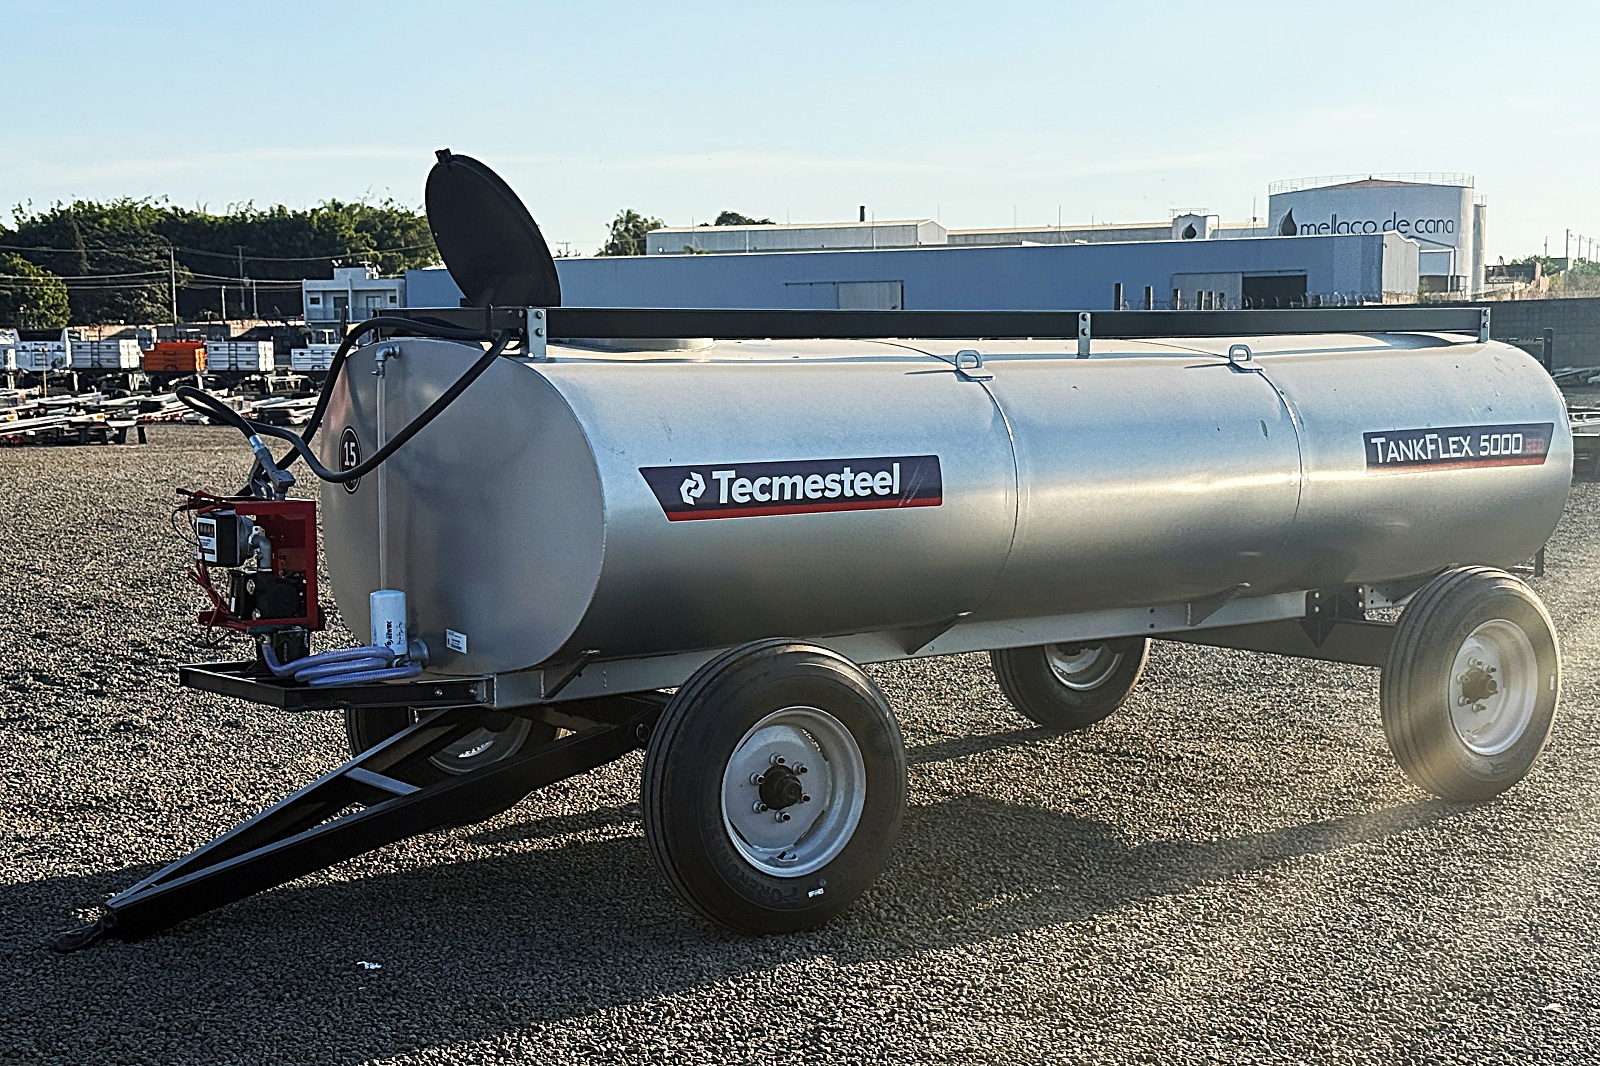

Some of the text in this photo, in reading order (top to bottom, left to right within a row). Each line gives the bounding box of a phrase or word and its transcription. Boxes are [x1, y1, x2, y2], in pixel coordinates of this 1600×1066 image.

[1382, 211, 1411, 234] de
[1414, 218, 1455, 234] cana
[343, 441, 357, 467] 15
[1479, 433, 1523, 456] 5000
[712, 462, 900, 504] Tecmesteel
